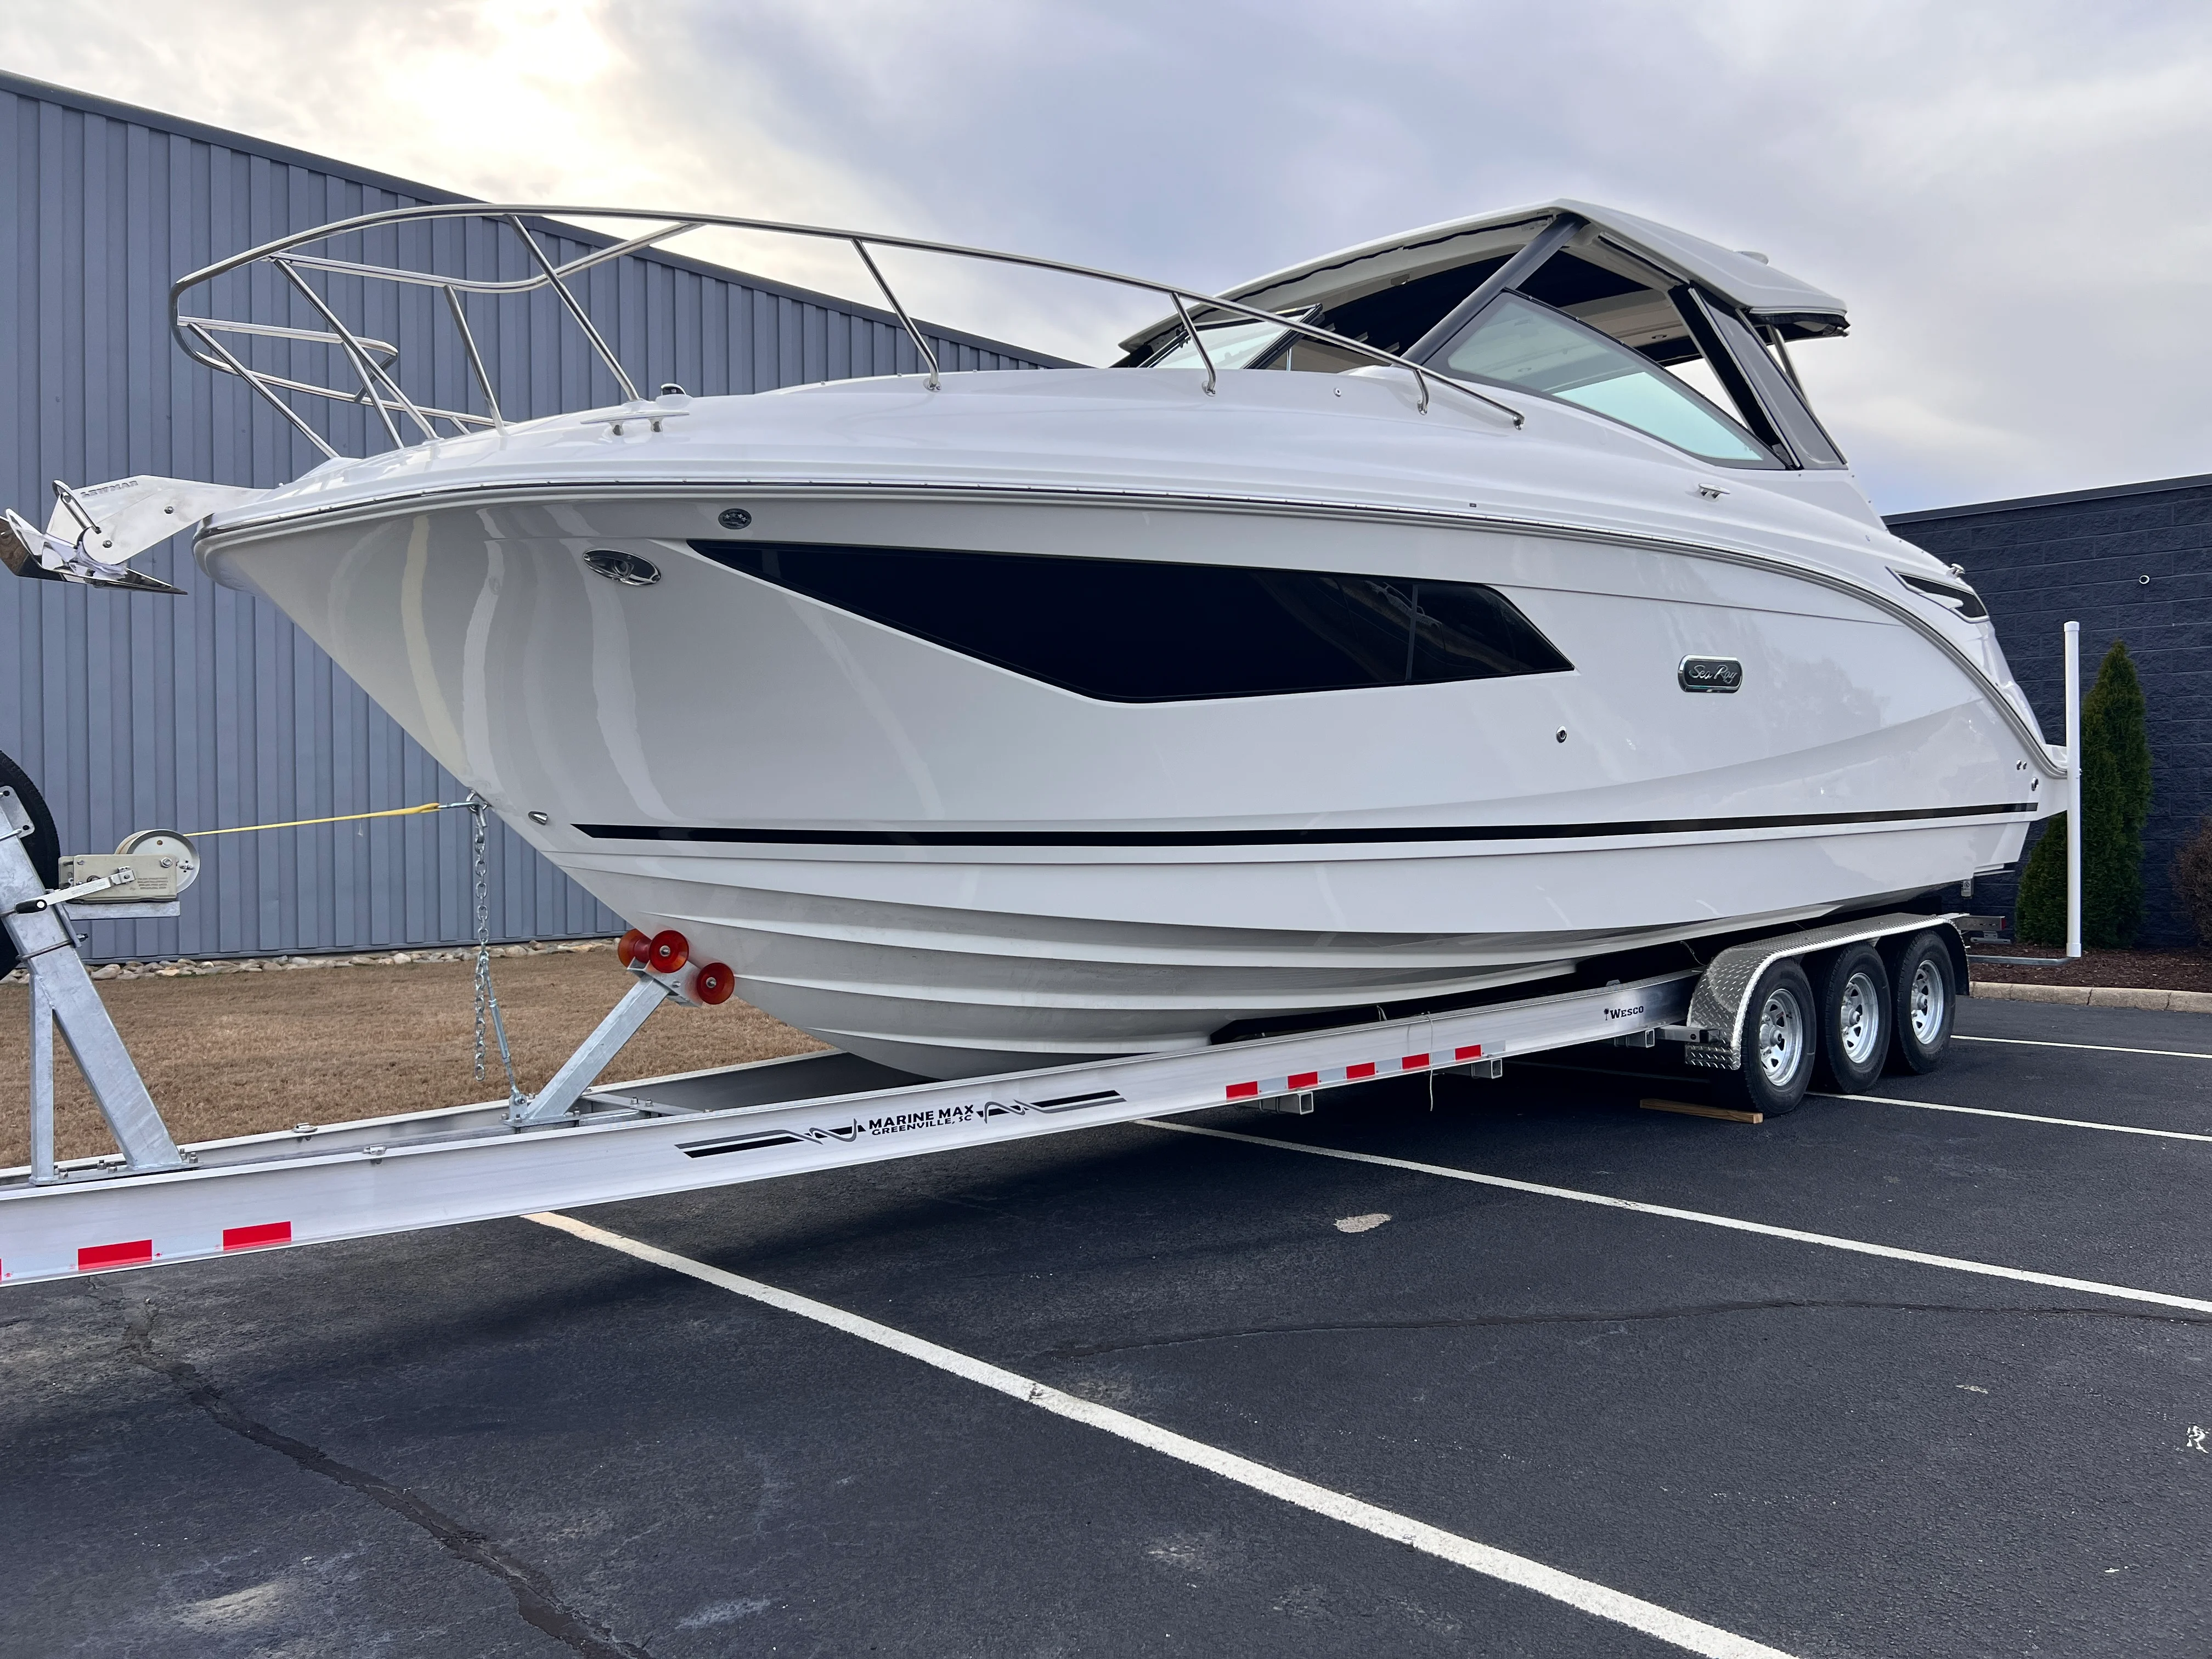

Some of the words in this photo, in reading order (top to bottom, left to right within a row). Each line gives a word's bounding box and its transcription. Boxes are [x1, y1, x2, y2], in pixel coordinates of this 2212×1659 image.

[1688, 664, 1713, 680] Sea
[1713, 664, 1738, 684] Ray
[869, 1110, 934, 1130] MARINE
[939, 1104, 974, 1119] MAX
[872, 1118, 955, 1136] GREENVILLE,
